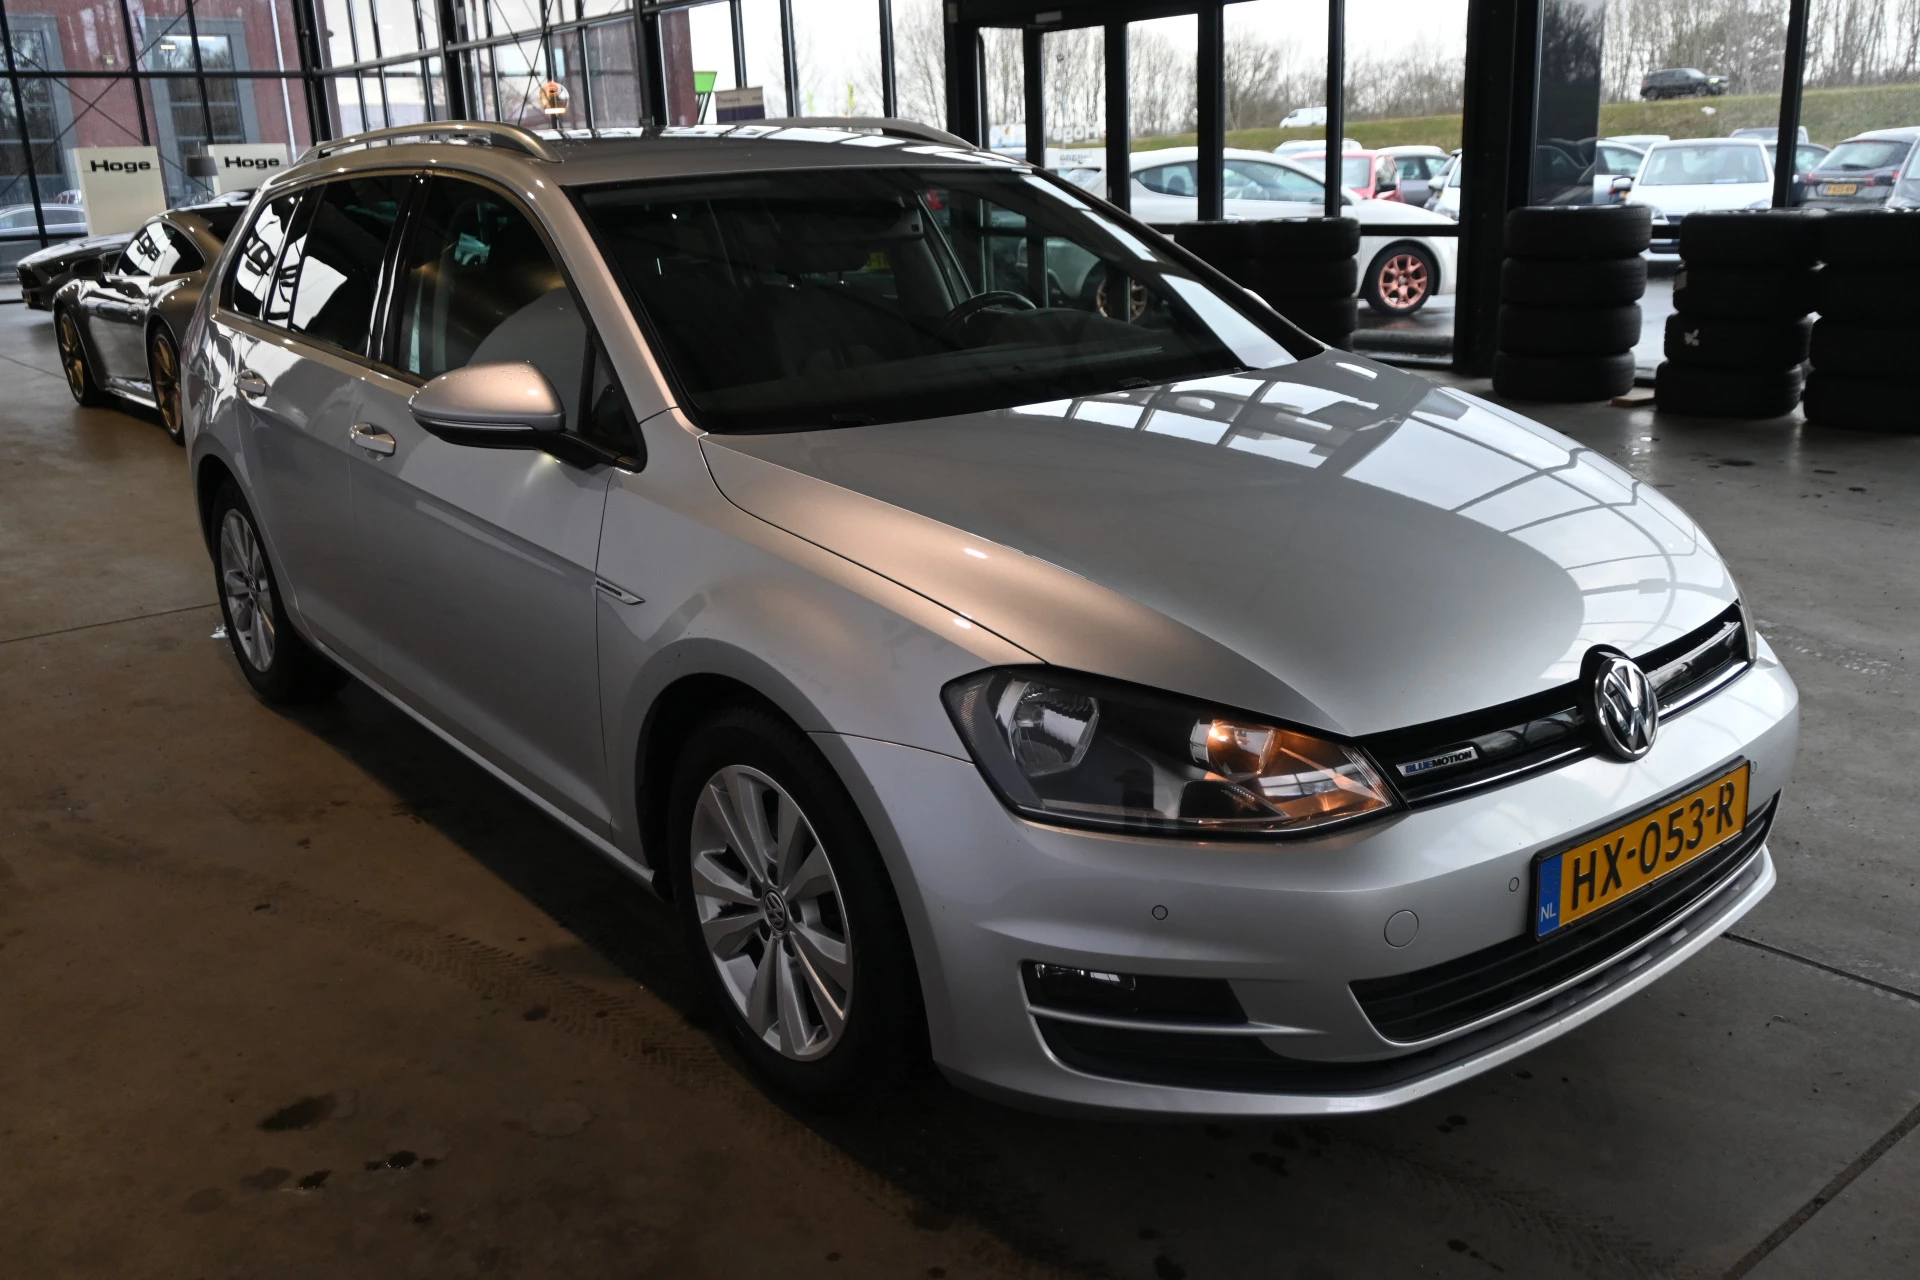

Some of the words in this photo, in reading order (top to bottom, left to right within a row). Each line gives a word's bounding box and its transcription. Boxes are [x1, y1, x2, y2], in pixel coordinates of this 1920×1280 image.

[90, 160, 151, 173] Hoge
[224, 156, 280, 169] Hoge
[1405, 751, 1472, 773] BLUEMOTION
[1572, 781, 1735, 911] HX-053-R
[1540, 903, 1556, 922] NL
